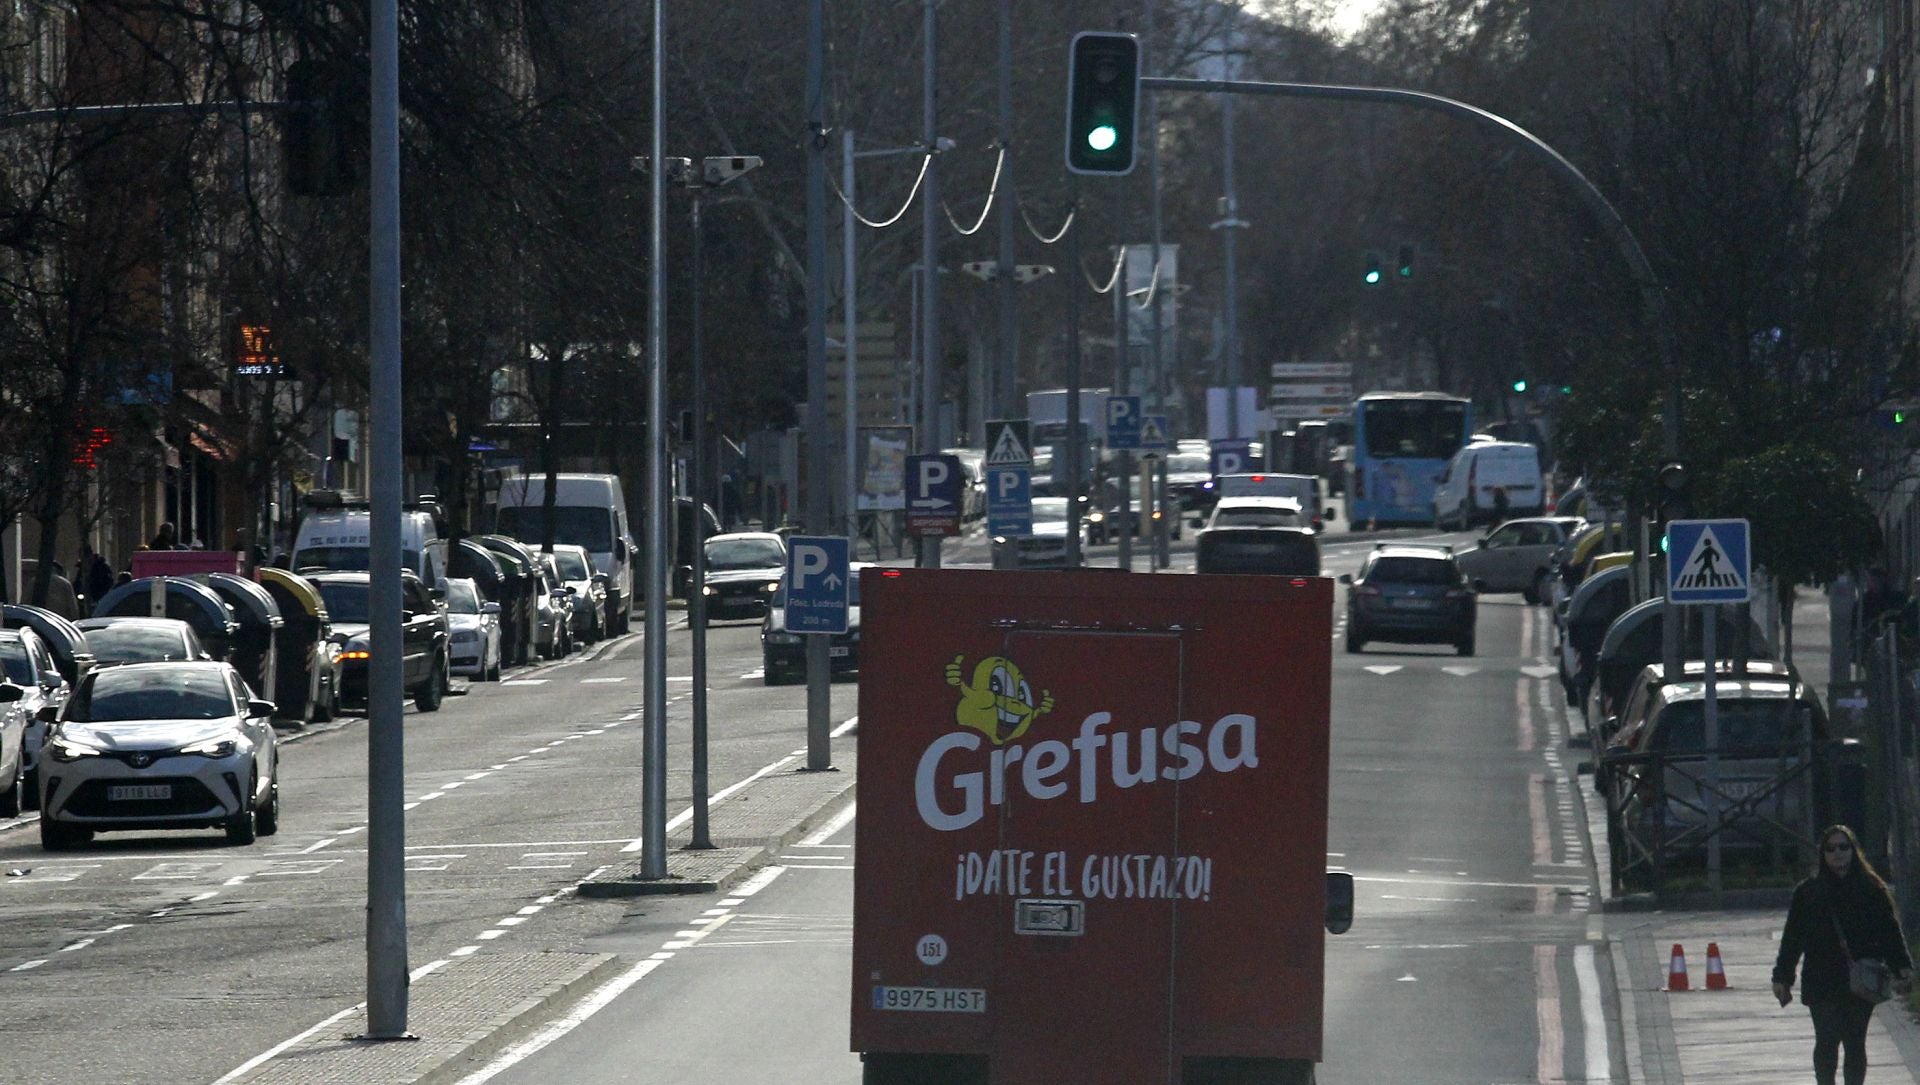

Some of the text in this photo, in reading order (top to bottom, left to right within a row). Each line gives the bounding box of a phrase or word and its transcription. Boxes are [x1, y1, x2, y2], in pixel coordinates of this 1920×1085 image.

[1110, 400, 1129, 426] P
[920, 461, 948, 497] P
[999, 471, 1019, 497] P
[793, 545, 828, 589] P
[914, 711, 1259, 831] Grefusa
[956, 849, 1213, 902] ¡DATE EL GUSTAZO!
[921, 942, 942, 957] 151
[887, 990, 981, 1010] 9975 HST
